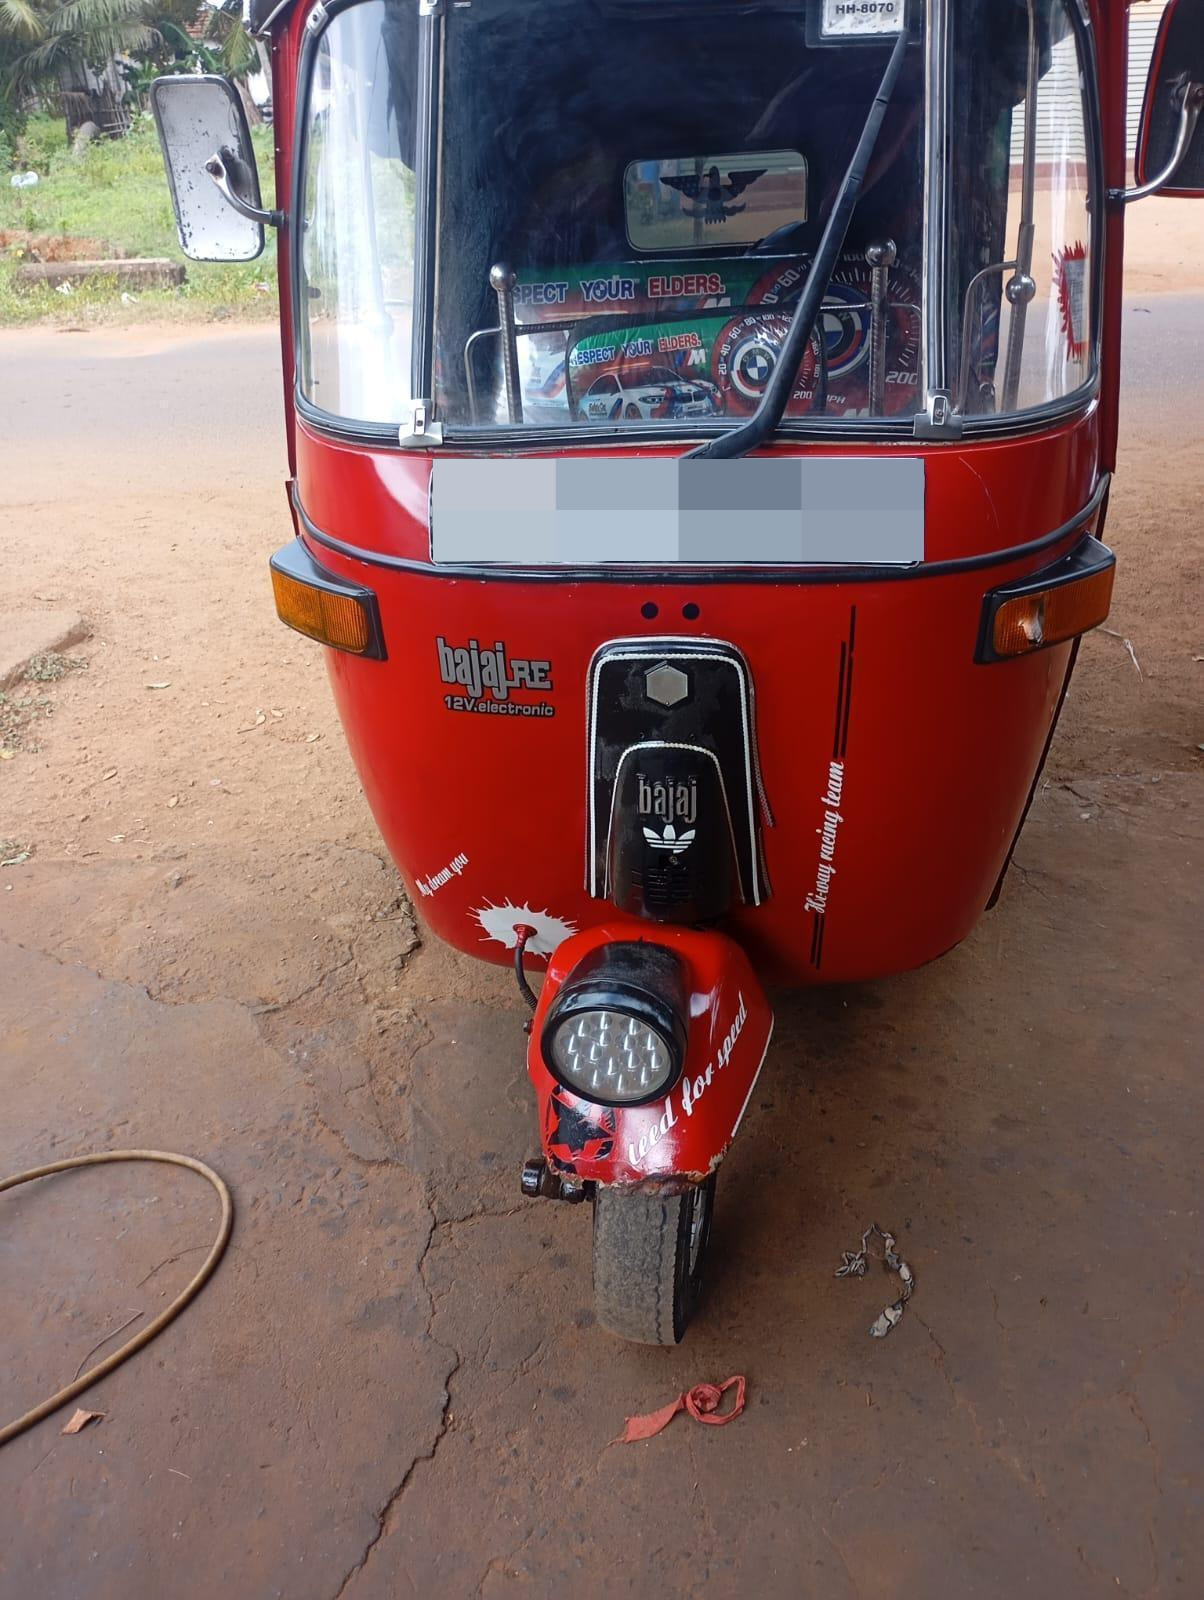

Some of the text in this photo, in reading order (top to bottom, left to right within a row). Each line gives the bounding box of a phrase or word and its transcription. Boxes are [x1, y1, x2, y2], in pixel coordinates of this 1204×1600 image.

[836, 2, 894, 14] HH-8070
[513, 282, 568, 305] SPECT
[648, 273, 725, 298] ELDERS.
[777, 269, 800, 287] 60
[622, 340, 652, 358] YOUR
[658, 332, 702, 352] ELDERS.
[729, 326, 742, 340] 60
[720, 344, 731, 357] 40
[793, 390, 813, 400] 200
[435, 636, 553, 699] bajaj RE
[444, 695, 556, 717] 12V.electronic
[821, 761, 845, 807] team
[637, 774, 698, 823] bajaj
[816, 810, 844, 861] racing
[449, 852, 470, 876] you
[681, 1063, 715, 1115] for
[718, 991, 748, 1069] speed
